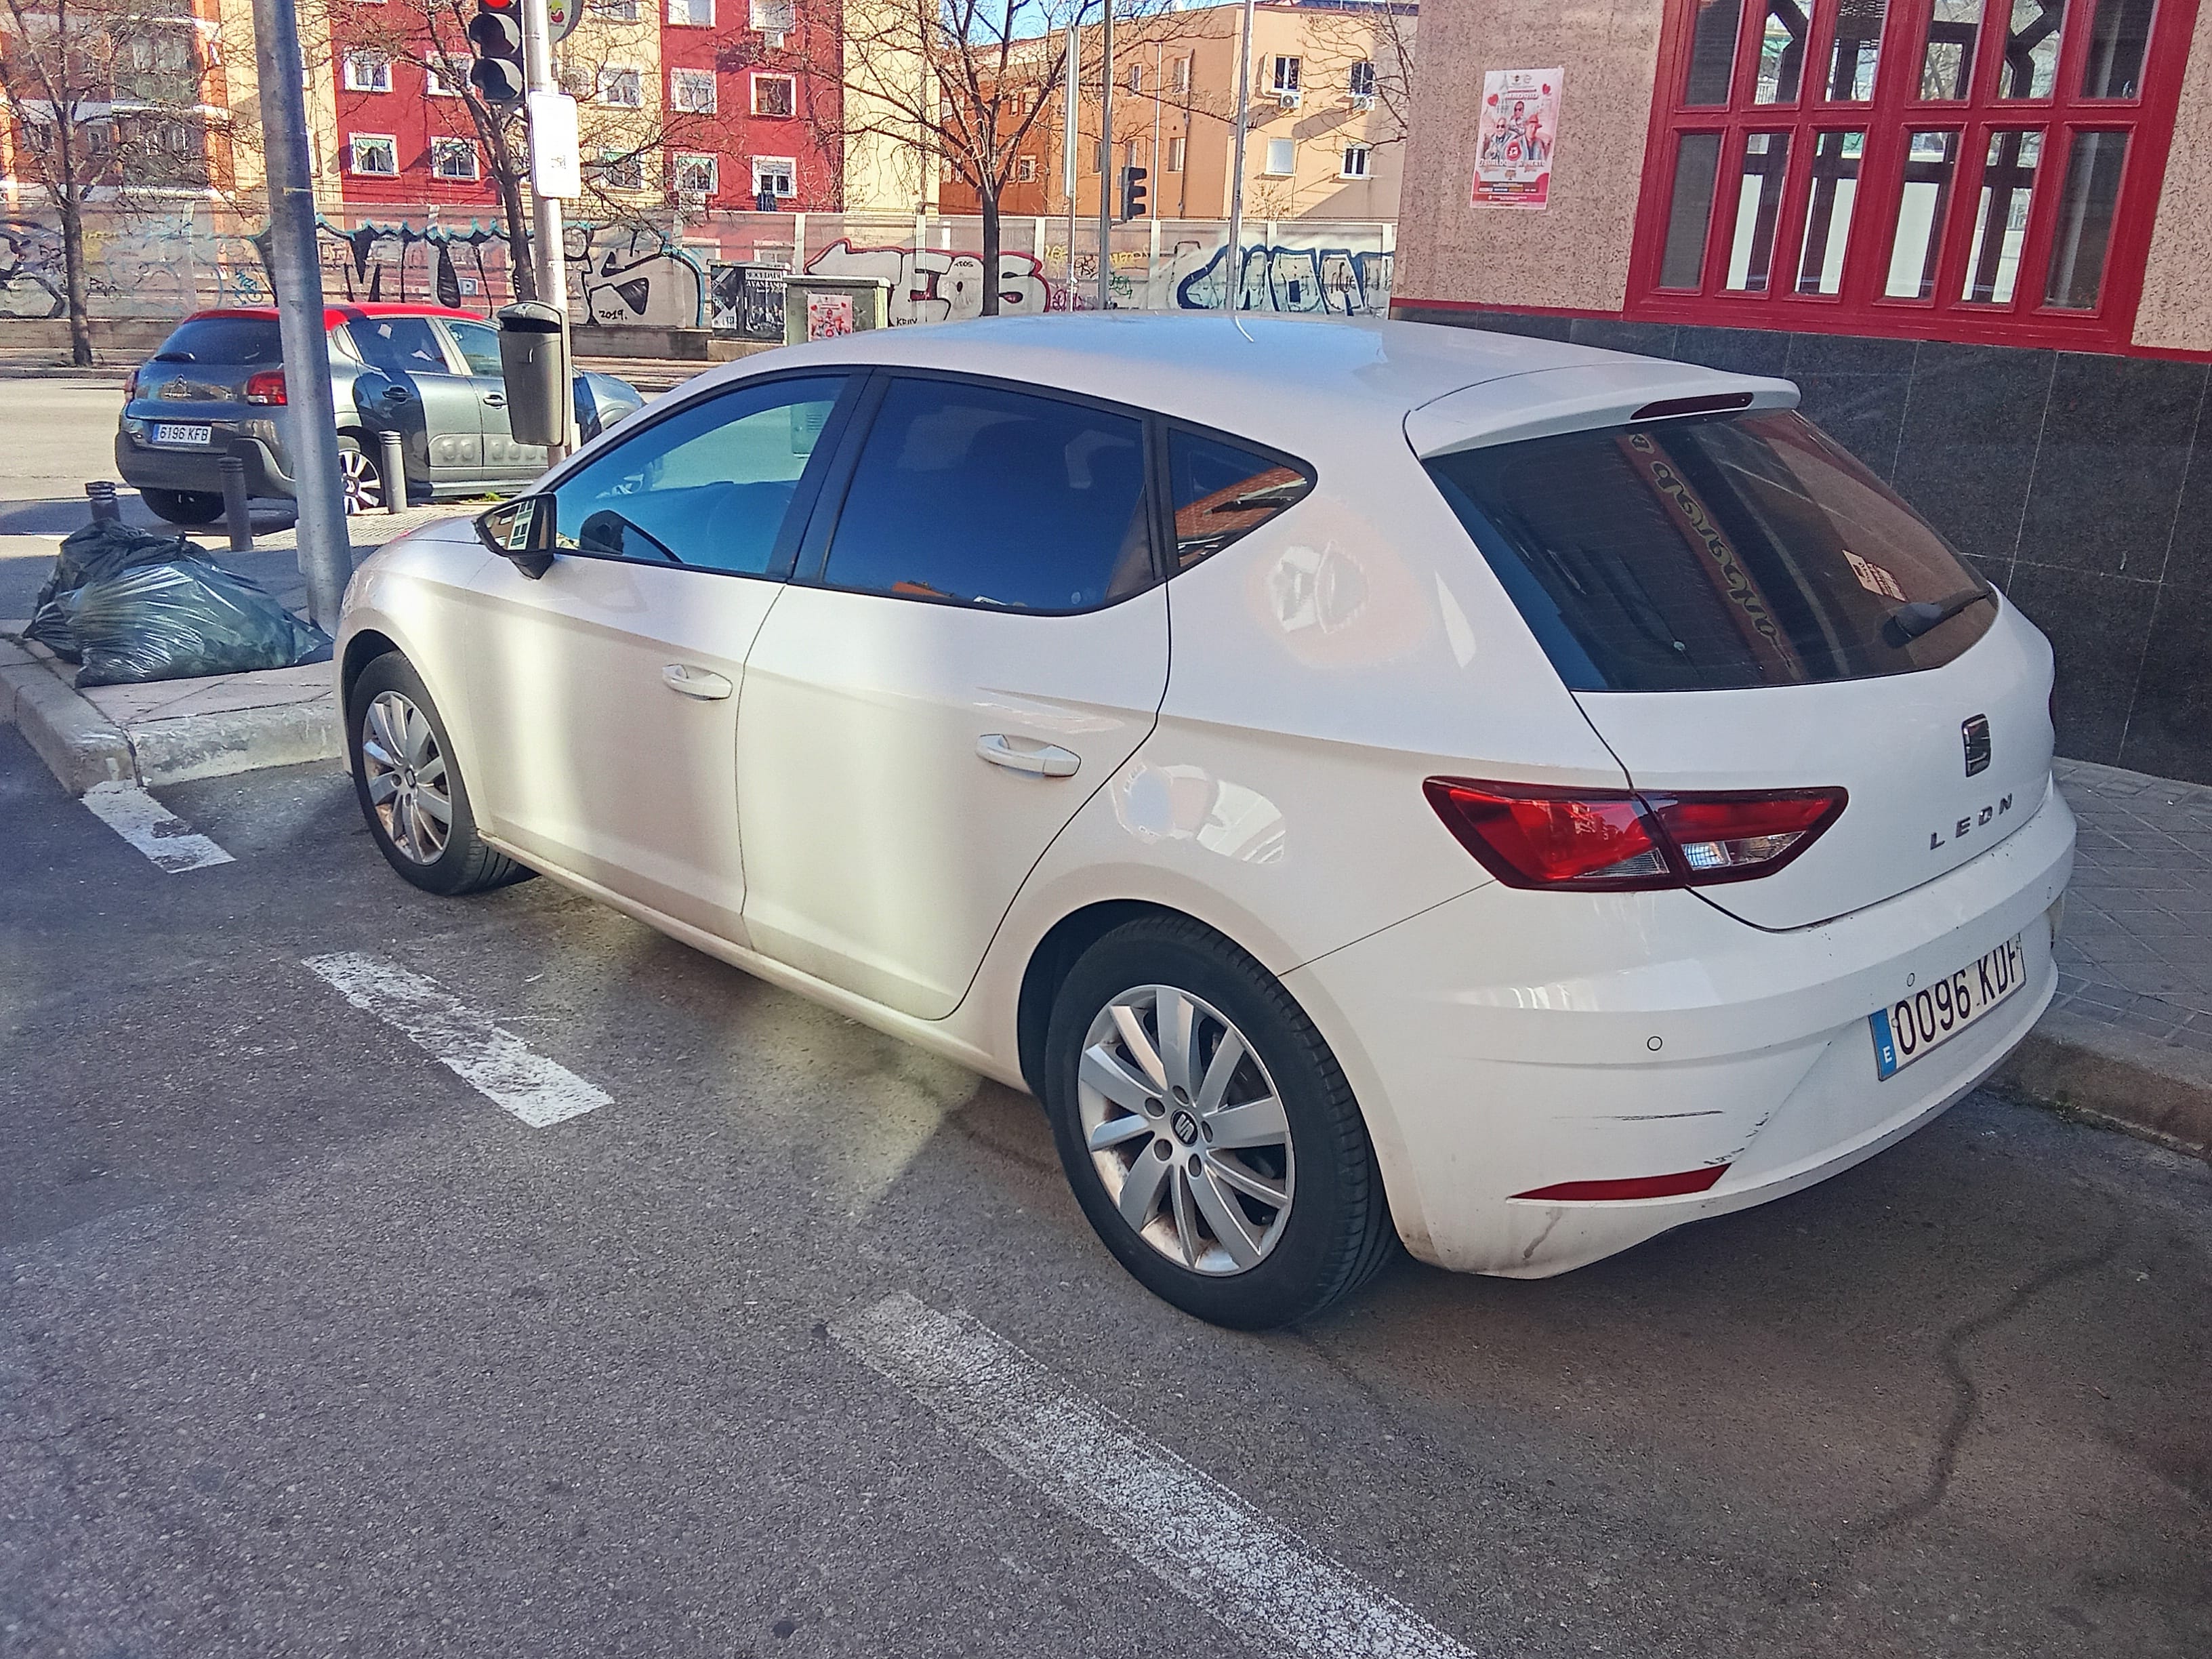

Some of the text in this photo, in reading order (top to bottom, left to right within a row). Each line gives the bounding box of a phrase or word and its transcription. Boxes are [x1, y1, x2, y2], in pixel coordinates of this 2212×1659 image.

[159, 426, 209, 441] 6196 KFB
[1929, 793, 2013, 851] LEON
[1894, 968, 1971, 1055] 0096
[1882, 1046, 1893, 1063] E
